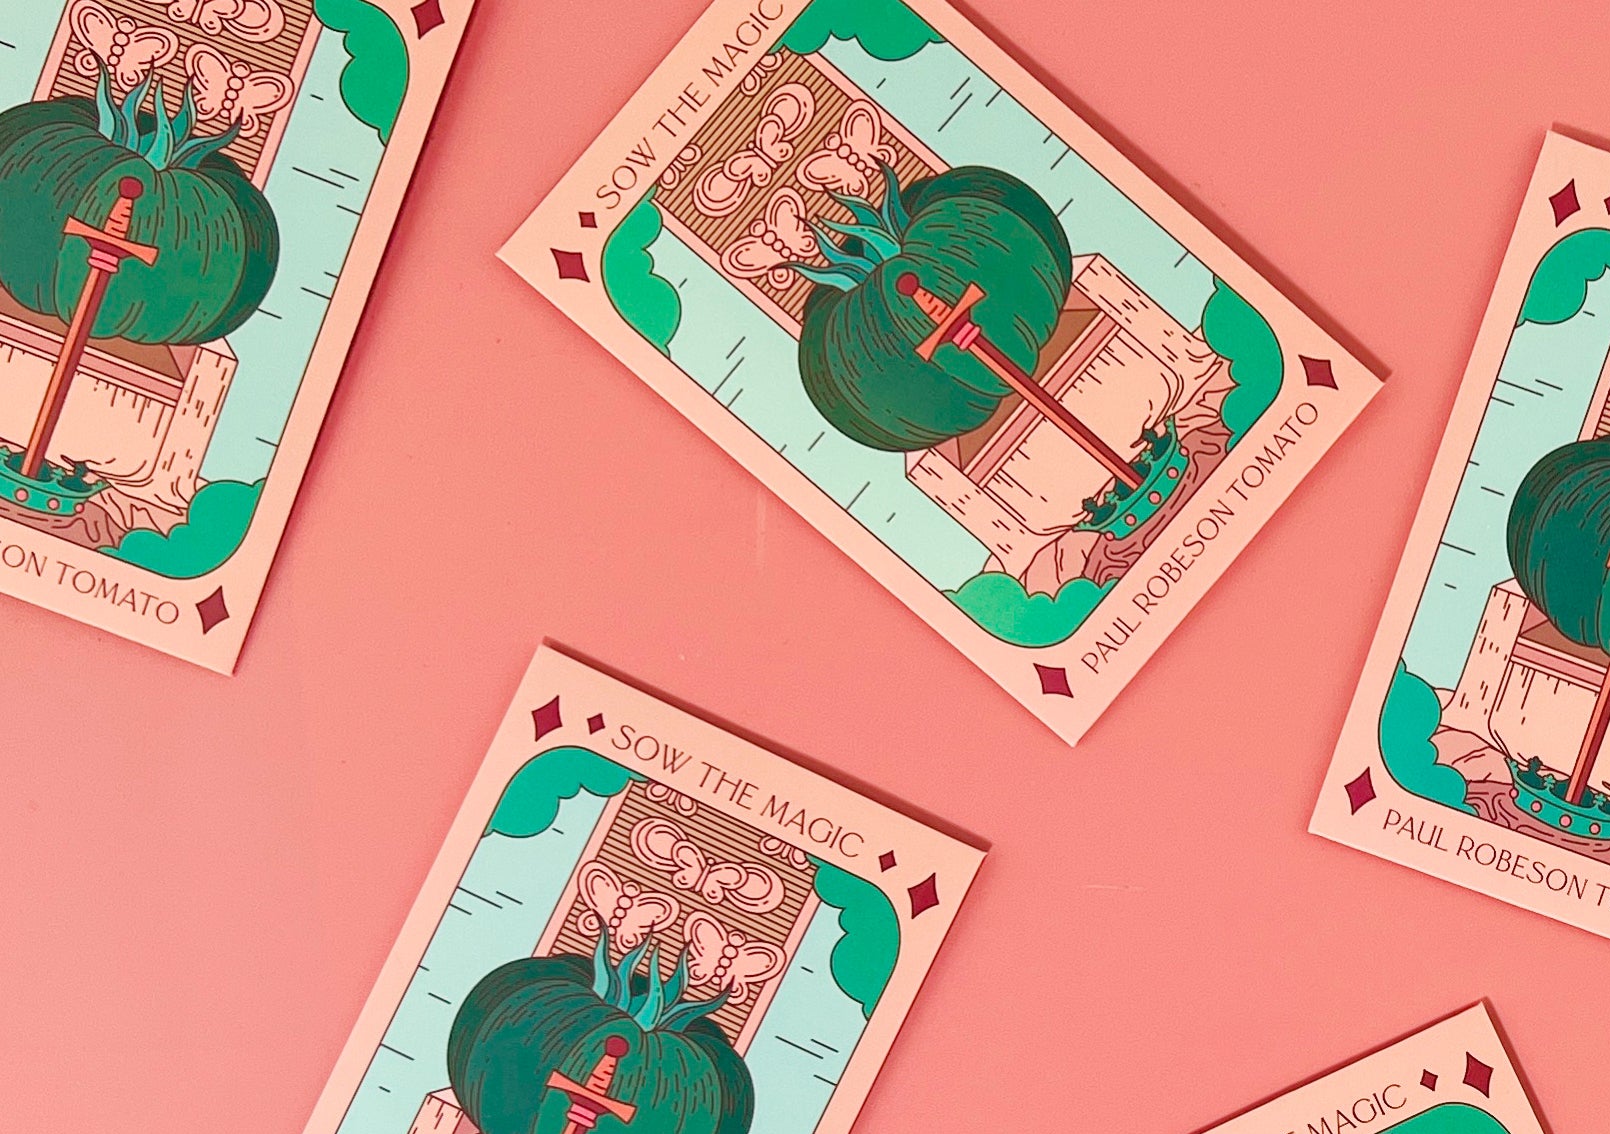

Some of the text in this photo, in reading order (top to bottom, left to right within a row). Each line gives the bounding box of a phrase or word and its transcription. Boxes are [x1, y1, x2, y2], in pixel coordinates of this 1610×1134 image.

[596, 0, 783, 210] SOW THE MAGIC
[56, 560, 180, 625] TOMATO
[1080, 402, 1318, 675] PAUL ROBESON TOMATO
[611, 724, 865, 858] SOW THE MAGIC
[1382, 808, 1448, 852] PAUL
[1456, 835, 1589, 900] ROBESON
